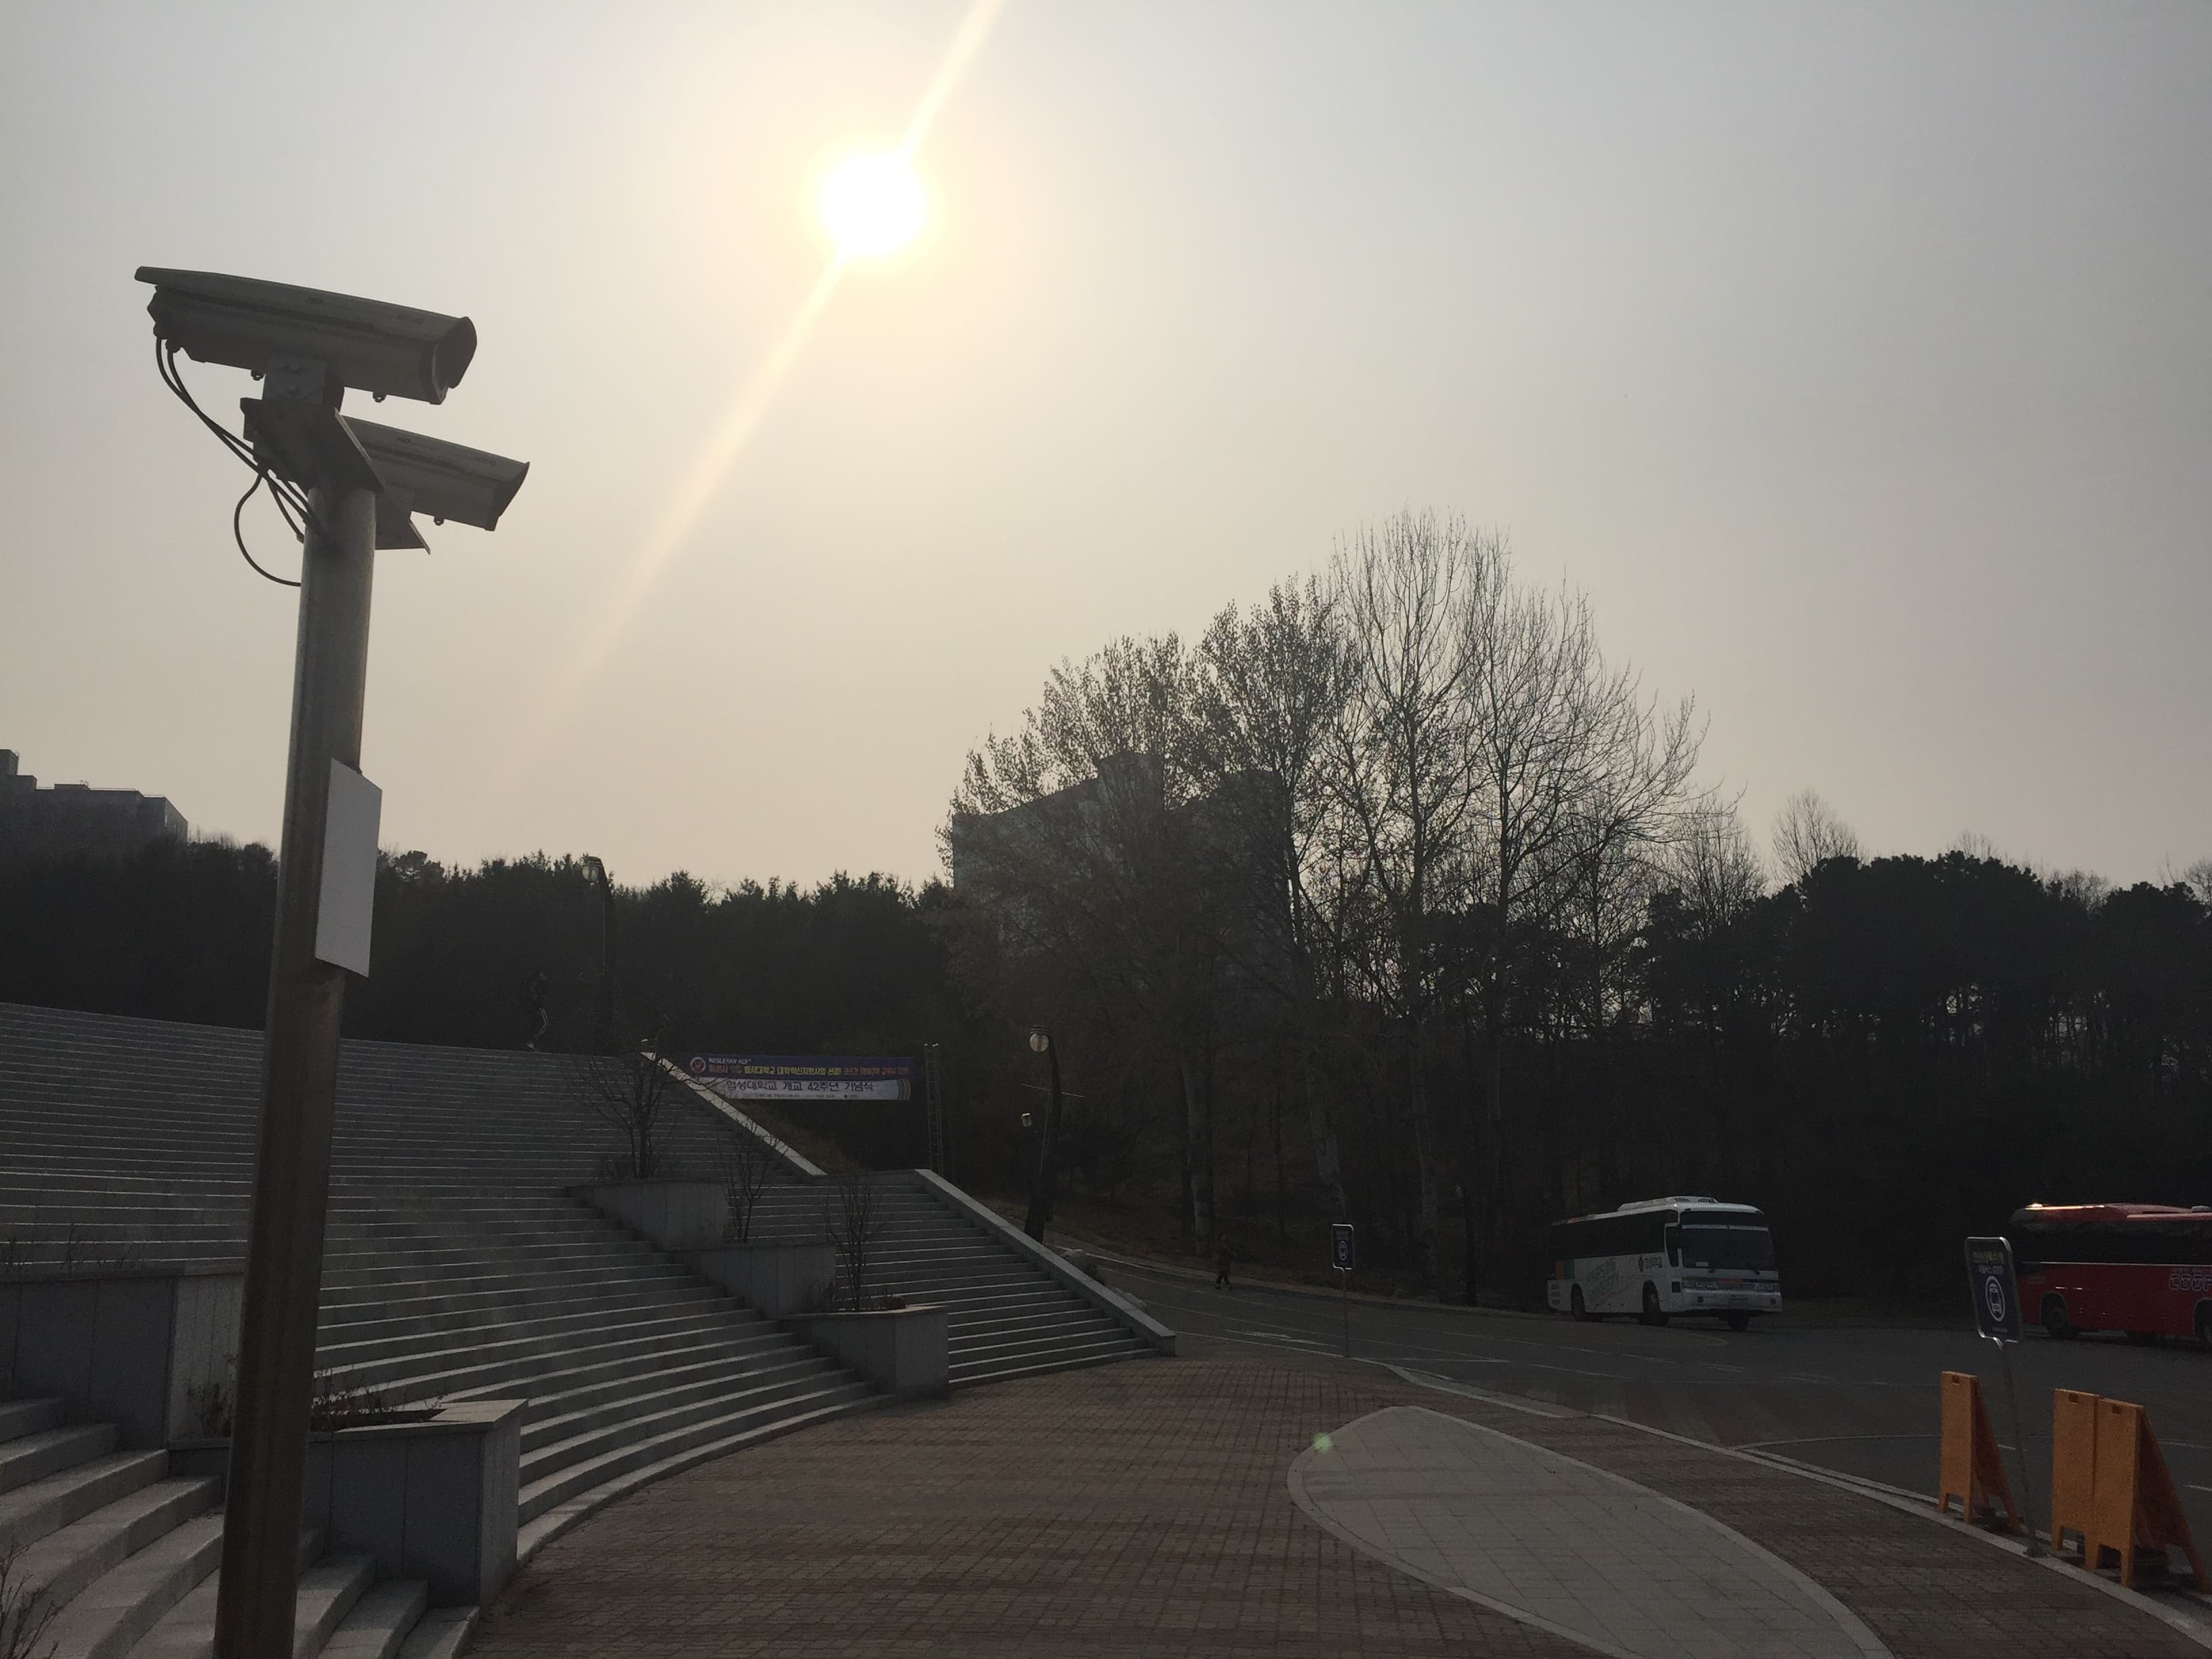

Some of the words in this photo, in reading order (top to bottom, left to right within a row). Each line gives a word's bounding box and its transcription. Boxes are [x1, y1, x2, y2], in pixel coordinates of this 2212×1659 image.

[726, 1080, 777, 1092] 협성대학교
[783, 1080, 802, 1092] 개교
[807, 1080, 839, 1092] 42주년
[844, 1080, 874, 1092] 기념식
